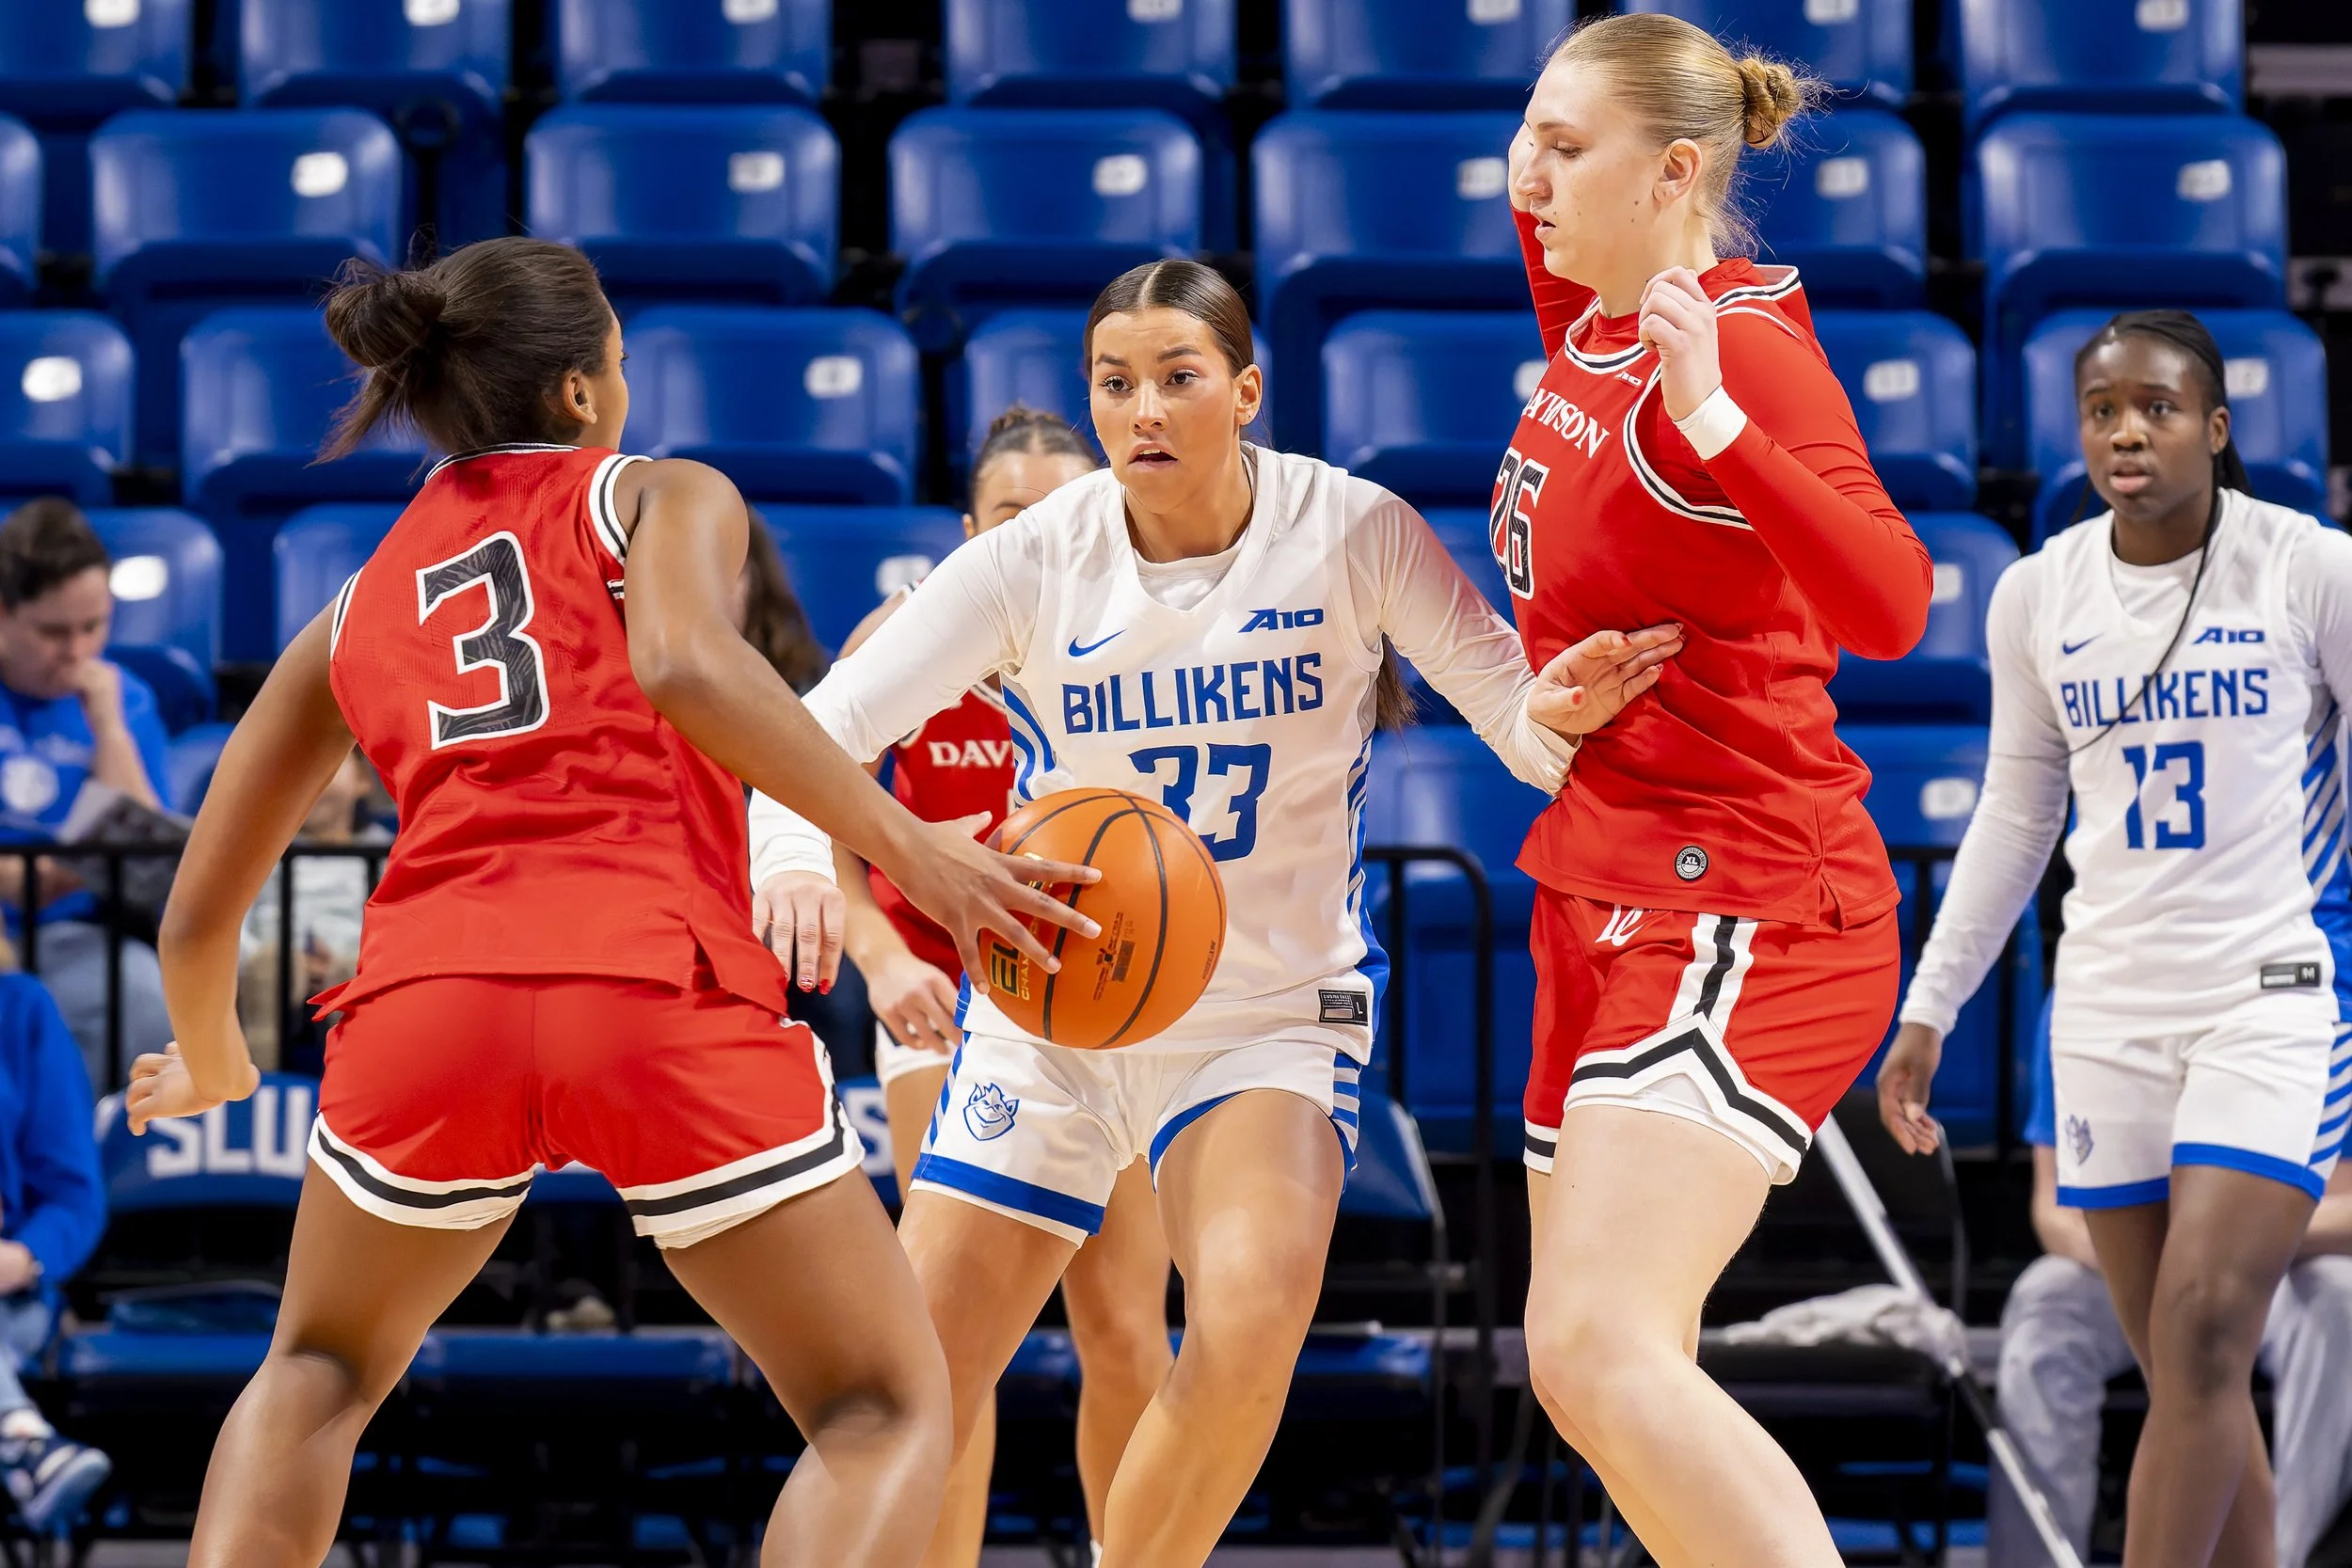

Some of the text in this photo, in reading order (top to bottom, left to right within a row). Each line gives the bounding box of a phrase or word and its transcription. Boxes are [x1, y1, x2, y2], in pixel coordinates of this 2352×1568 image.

[1521, 388, 1610, 459] AVIDSON
[415, 531, 550, 751] 3
[1237, 608, 1324, 633] A10
[2192, 626, 2265, 644] A10
[1061, 652, 1324, 736] BILLIKENS
[2060, 668, 2269, 728] BILLIKENS
[927, 739, 1015, 768] DAV
[1127, 742, 1272, 863] 33
[2122, 740, 2206, 850] 13
[1685, 856, 1698, 865] XL
[1356, 1001, 1364, 1015] L
[147, 1085, 311, 1180] SLU
